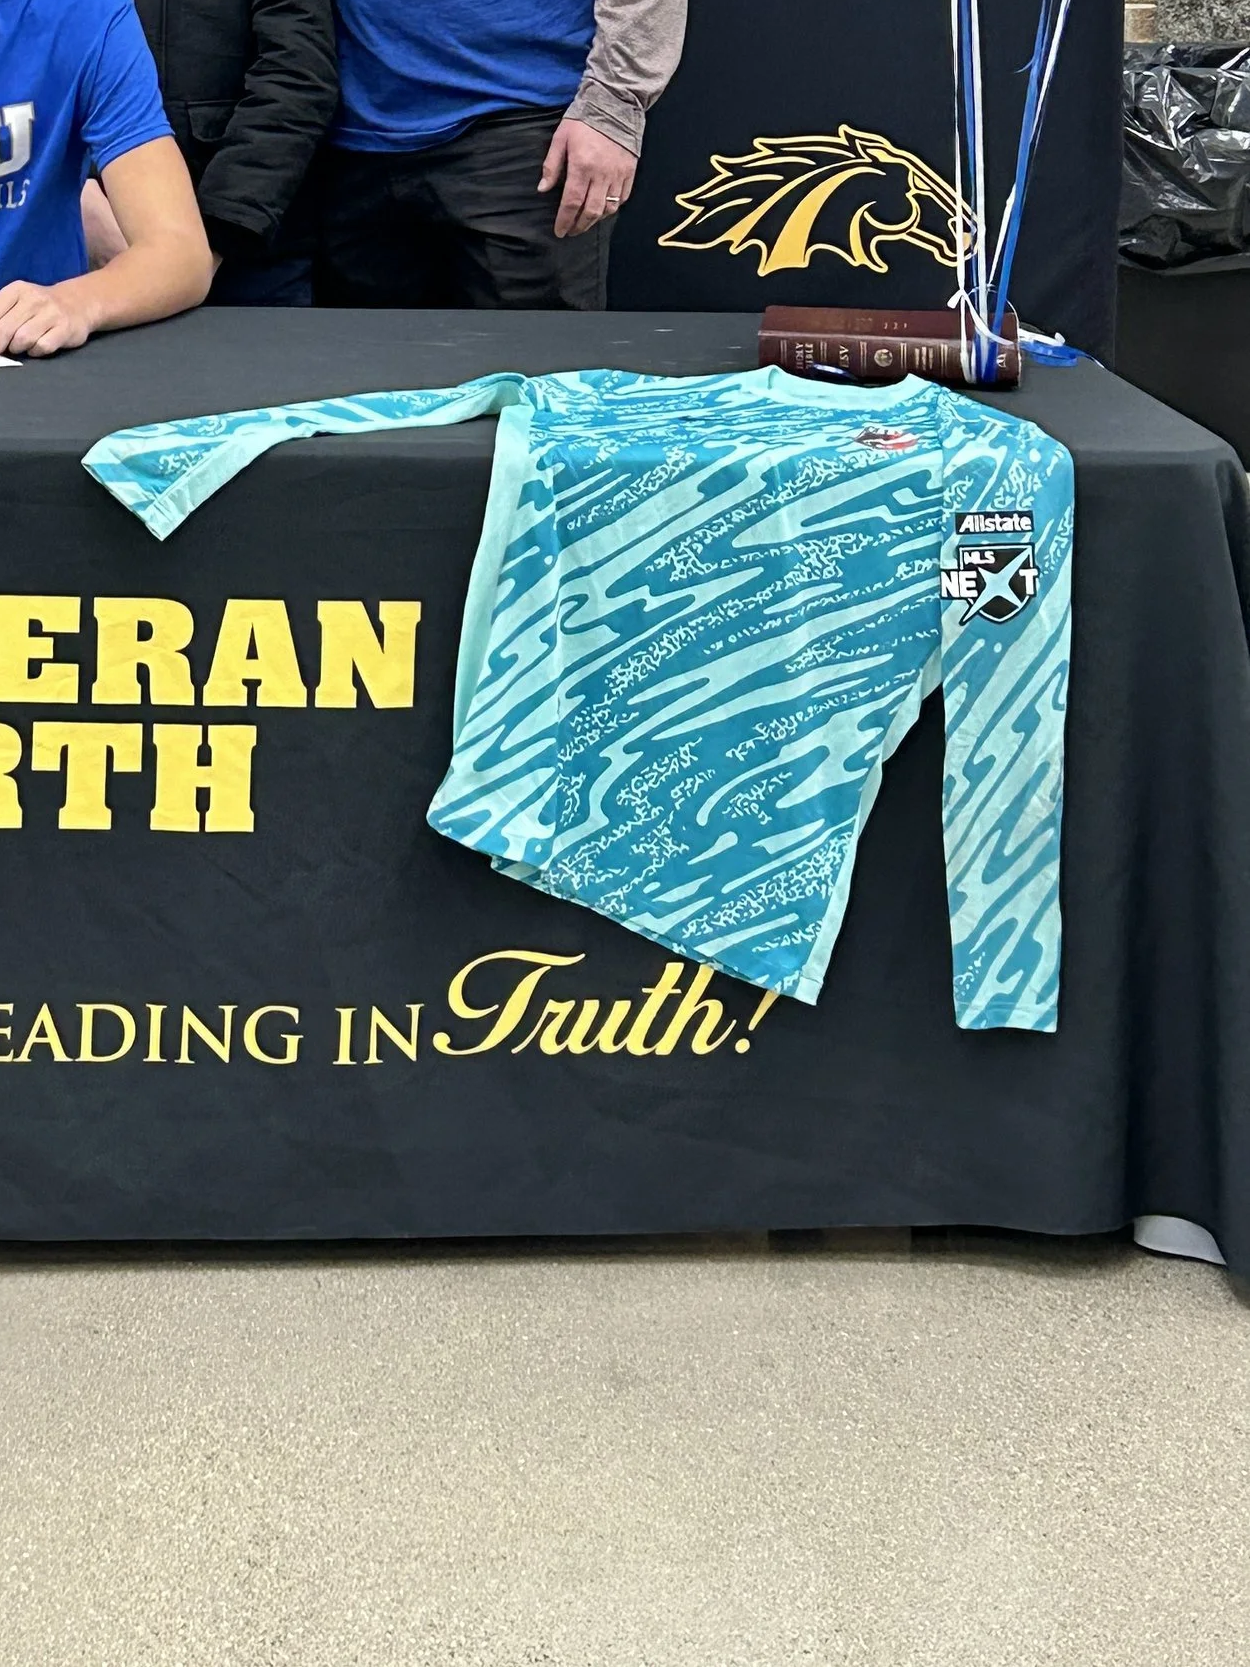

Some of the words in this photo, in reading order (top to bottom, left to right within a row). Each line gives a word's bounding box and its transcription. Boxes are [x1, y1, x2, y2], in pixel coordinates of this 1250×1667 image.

[959, 513, 1032, 533] Allstate
[963, 551, 995, 564] MLS
[334, 1002, 425, 1066] IN
[432, 949, 781, 1057] Truth!
